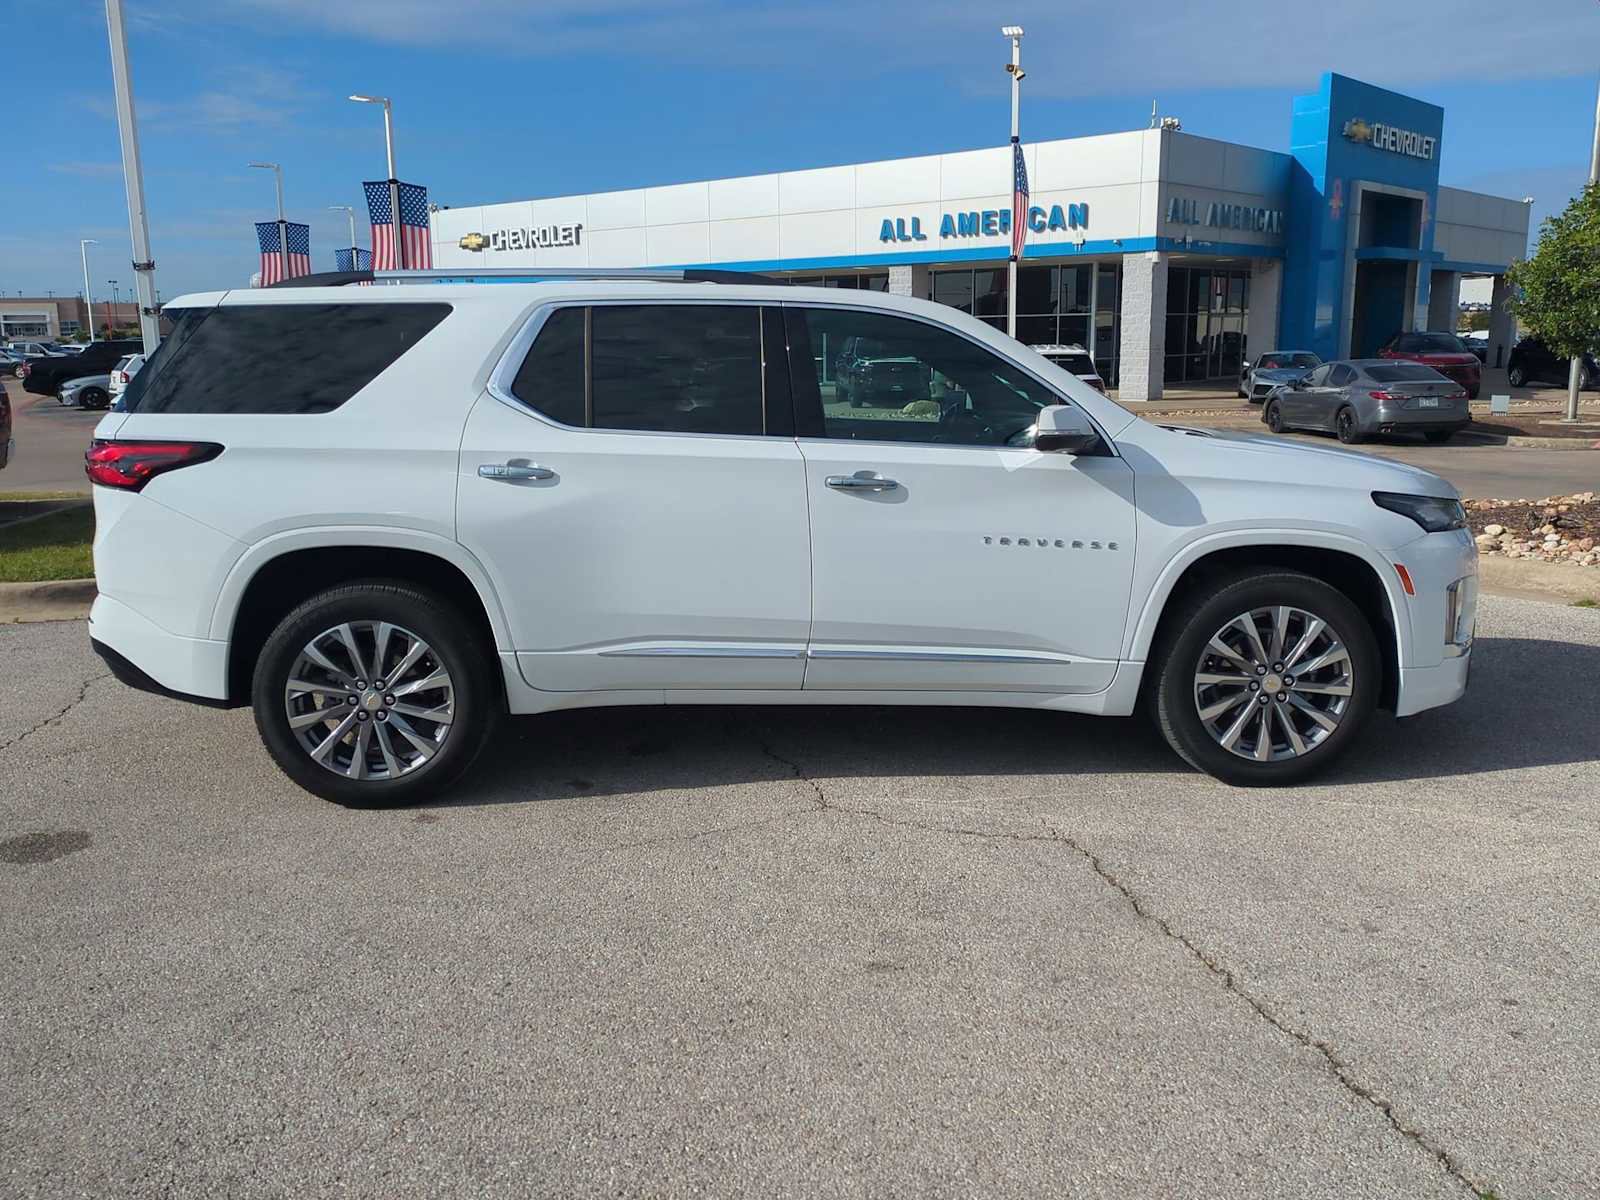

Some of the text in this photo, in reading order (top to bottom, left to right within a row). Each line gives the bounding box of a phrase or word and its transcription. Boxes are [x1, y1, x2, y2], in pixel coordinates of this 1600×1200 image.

[1374, 122, 1436, 159] CHEVROLET
[880, 203, 1089, 243] ALL AMERCAN
[1166, 197, 1282, 233] ALL AMERICAN
[489, 224, 582, 251] CHEVROLET
[983, 536, 1119, 550] TRAVERSE
